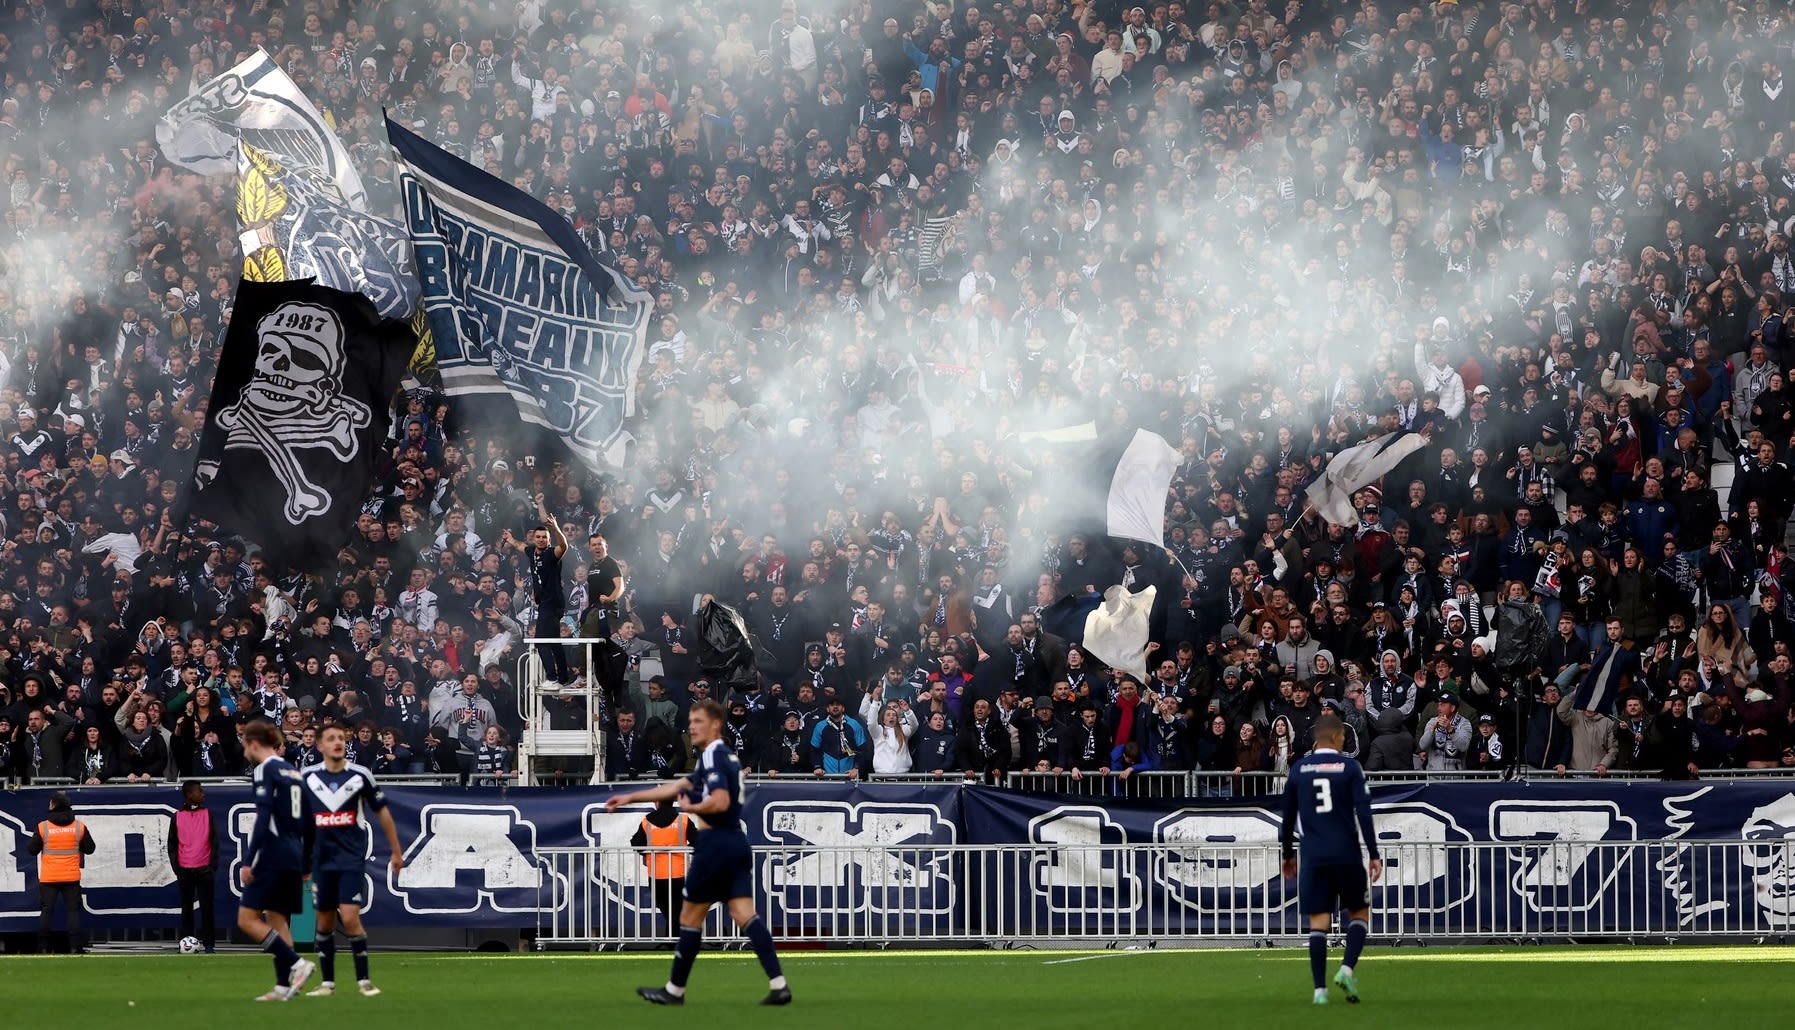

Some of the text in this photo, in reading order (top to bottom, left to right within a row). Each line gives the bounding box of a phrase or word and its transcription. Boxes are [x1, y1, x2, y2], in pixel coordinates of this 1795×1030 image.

[274, 312, 328, 332] 1987
[412, 241, 636, 390] BODEAUX
[290, 785, 302, 819] 8
[1313, 778, 1333, 814] 3
[315, 813, 353, 826] Betclic
